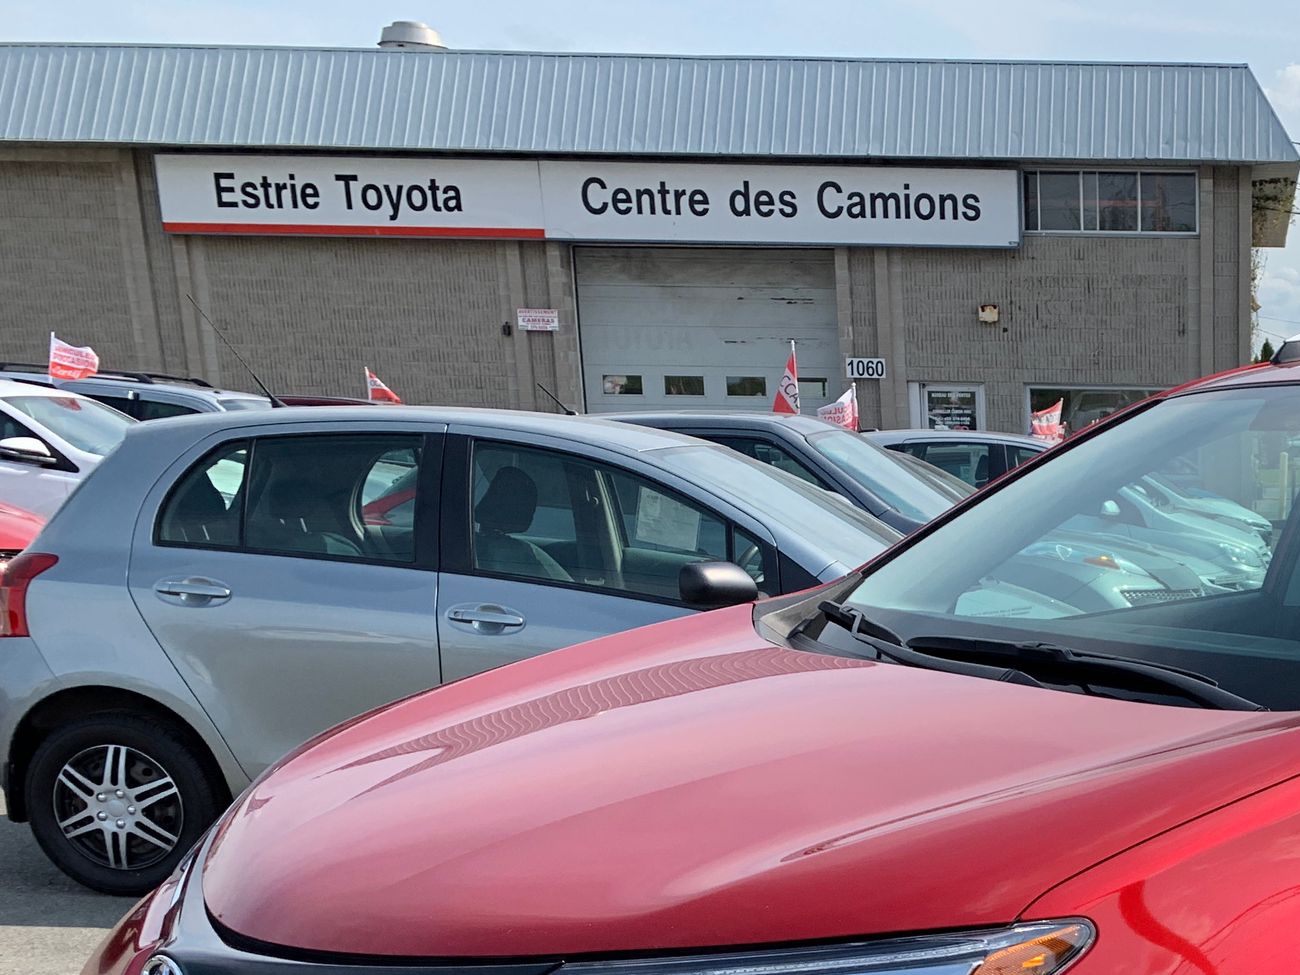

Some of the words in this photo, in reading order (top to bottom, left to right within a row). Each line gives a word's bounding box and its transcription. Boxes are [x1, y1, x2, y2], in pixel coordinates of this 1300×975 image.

[213, 172, 320, 210] Estrie
[334, 173, 463, 221] Toyota
[581, 176, 710, 217] Centre
[729, 180, 798, 218] des
[816, 181, 982, 222] Camions
[847, 359, 885, 377] 1060
